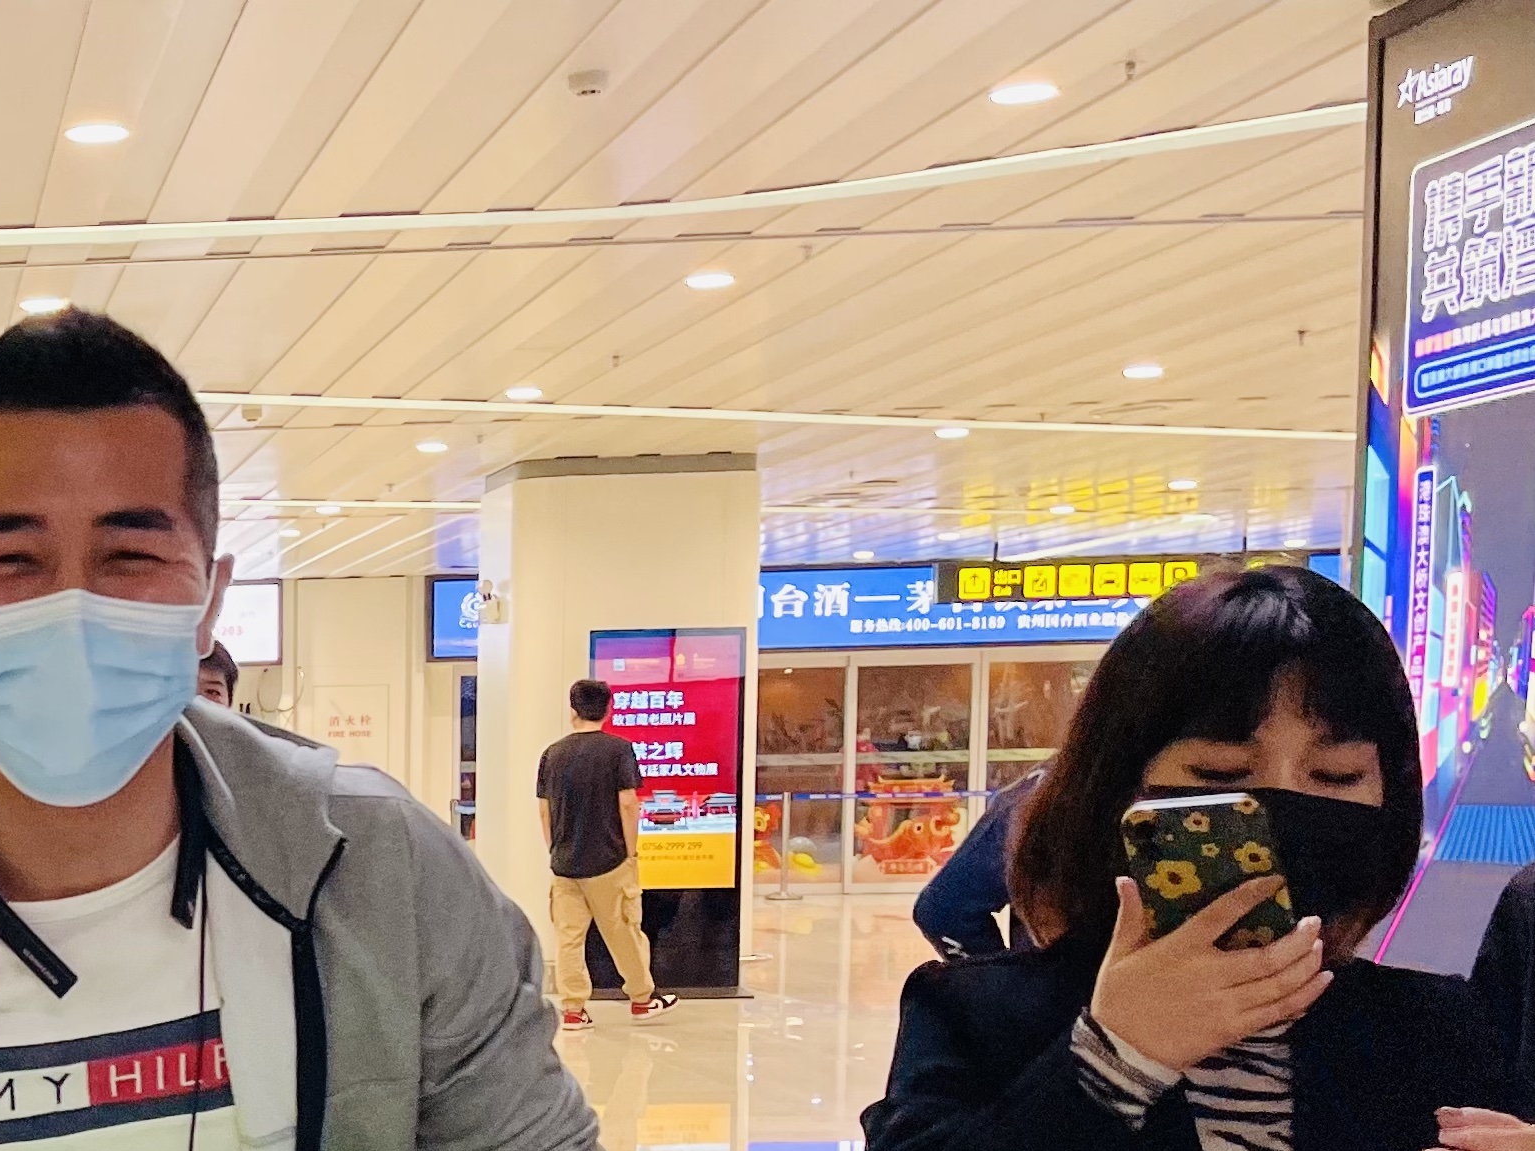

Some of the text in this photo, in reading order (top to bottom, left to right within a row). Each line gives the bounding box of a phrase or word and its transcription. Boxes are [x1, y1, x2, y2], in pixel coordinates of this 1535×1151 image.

[1416, 55, 1474, 101] Asiaray
[613, 690, 684, 710] 穿越百年
[329, 714, 372, 727] 消火栓
